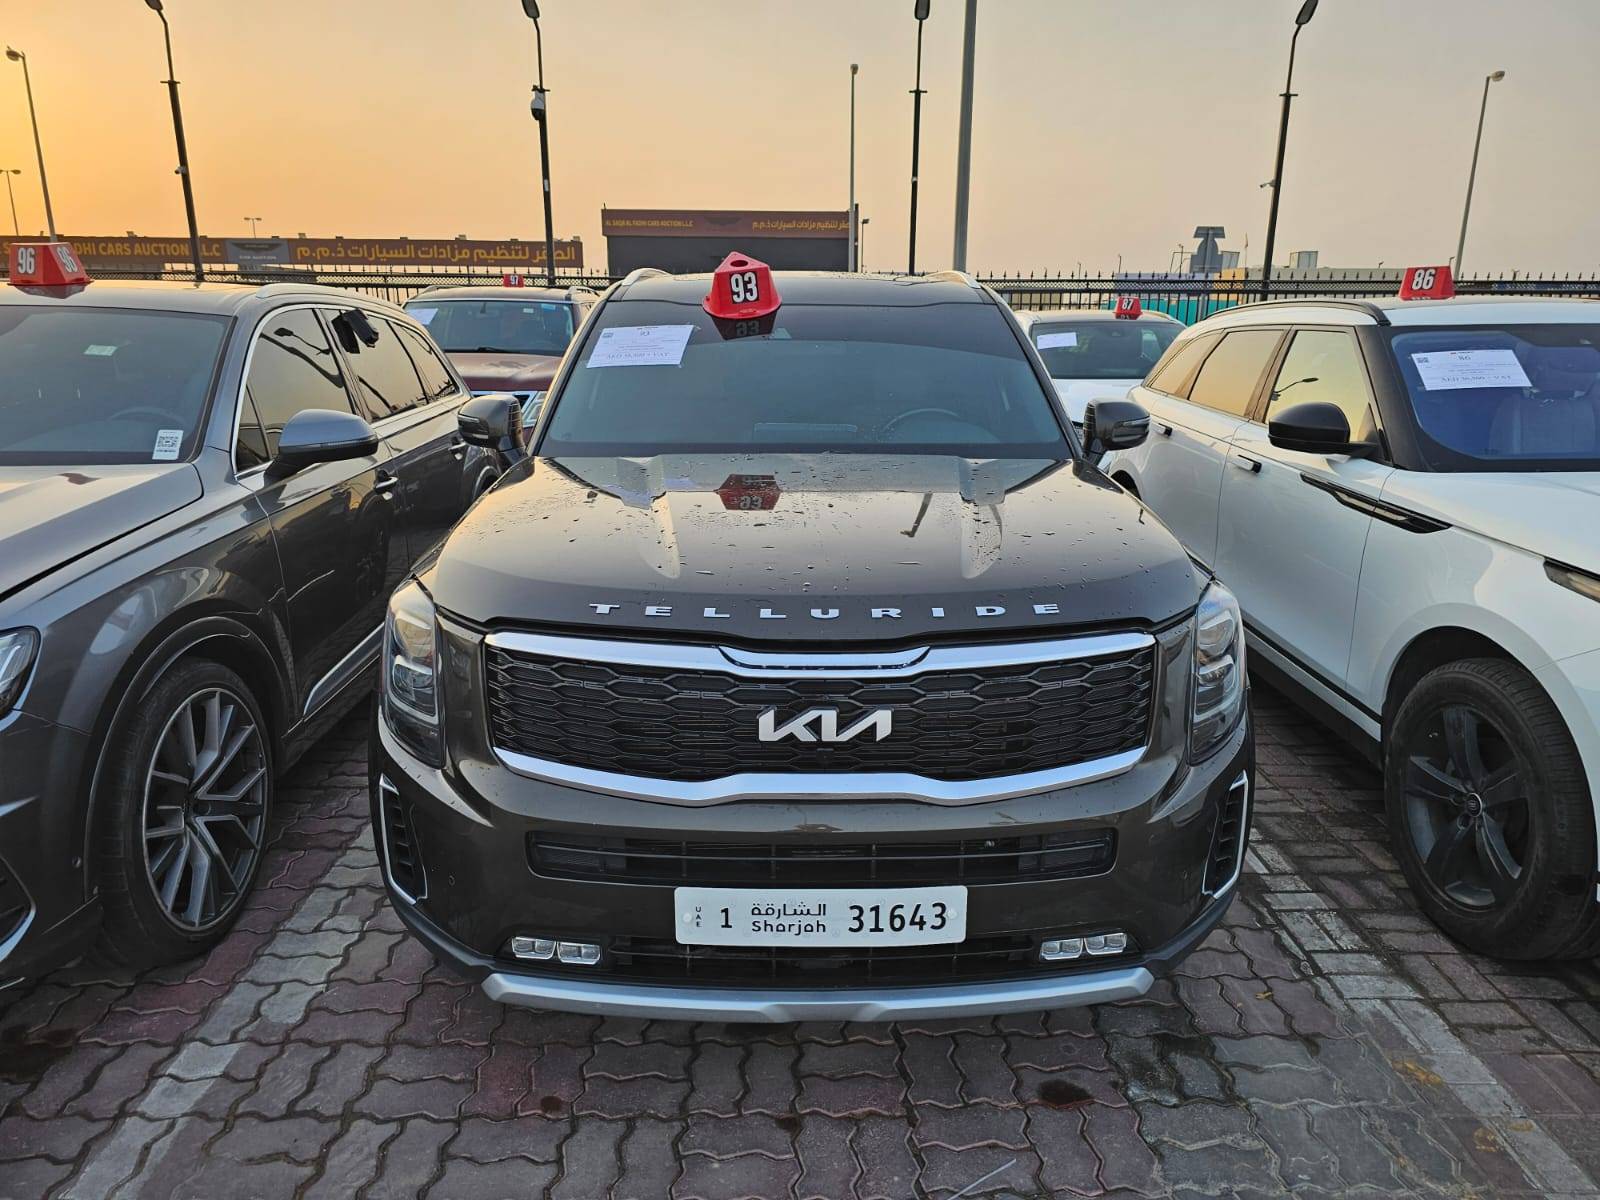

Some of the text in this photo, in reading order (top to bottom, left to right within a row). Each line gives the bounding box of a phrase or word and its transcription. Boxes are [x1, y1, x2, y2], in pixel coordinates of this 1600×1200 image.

[98, 242, 132, 256] CARS
[134, 243, 189, 256] AUCTION
[348, 244, 415, 261] السيارات
[418, 244, 469, 261] مزادات
[473, 245, 529, 262] لتنظيم
[17, 247, 35, 274] 96
[56, 246, 78, 273] 96
[510, 274, 519, 286] 97
[730, 271, 759, 303] 93
[1412, 268, 1436, 290] 86
[1121, 298, 1134, 310] 87
[589, 602, 1062, 620] TELLURIDE
[758, 706, 893, 742] KIA
[720, 907, 733, 929] 1
[751, 901, 827, 918] الشارقة
[847, 902, 947, 933] 31643
[751, 920, 827, 936] Sharjah
